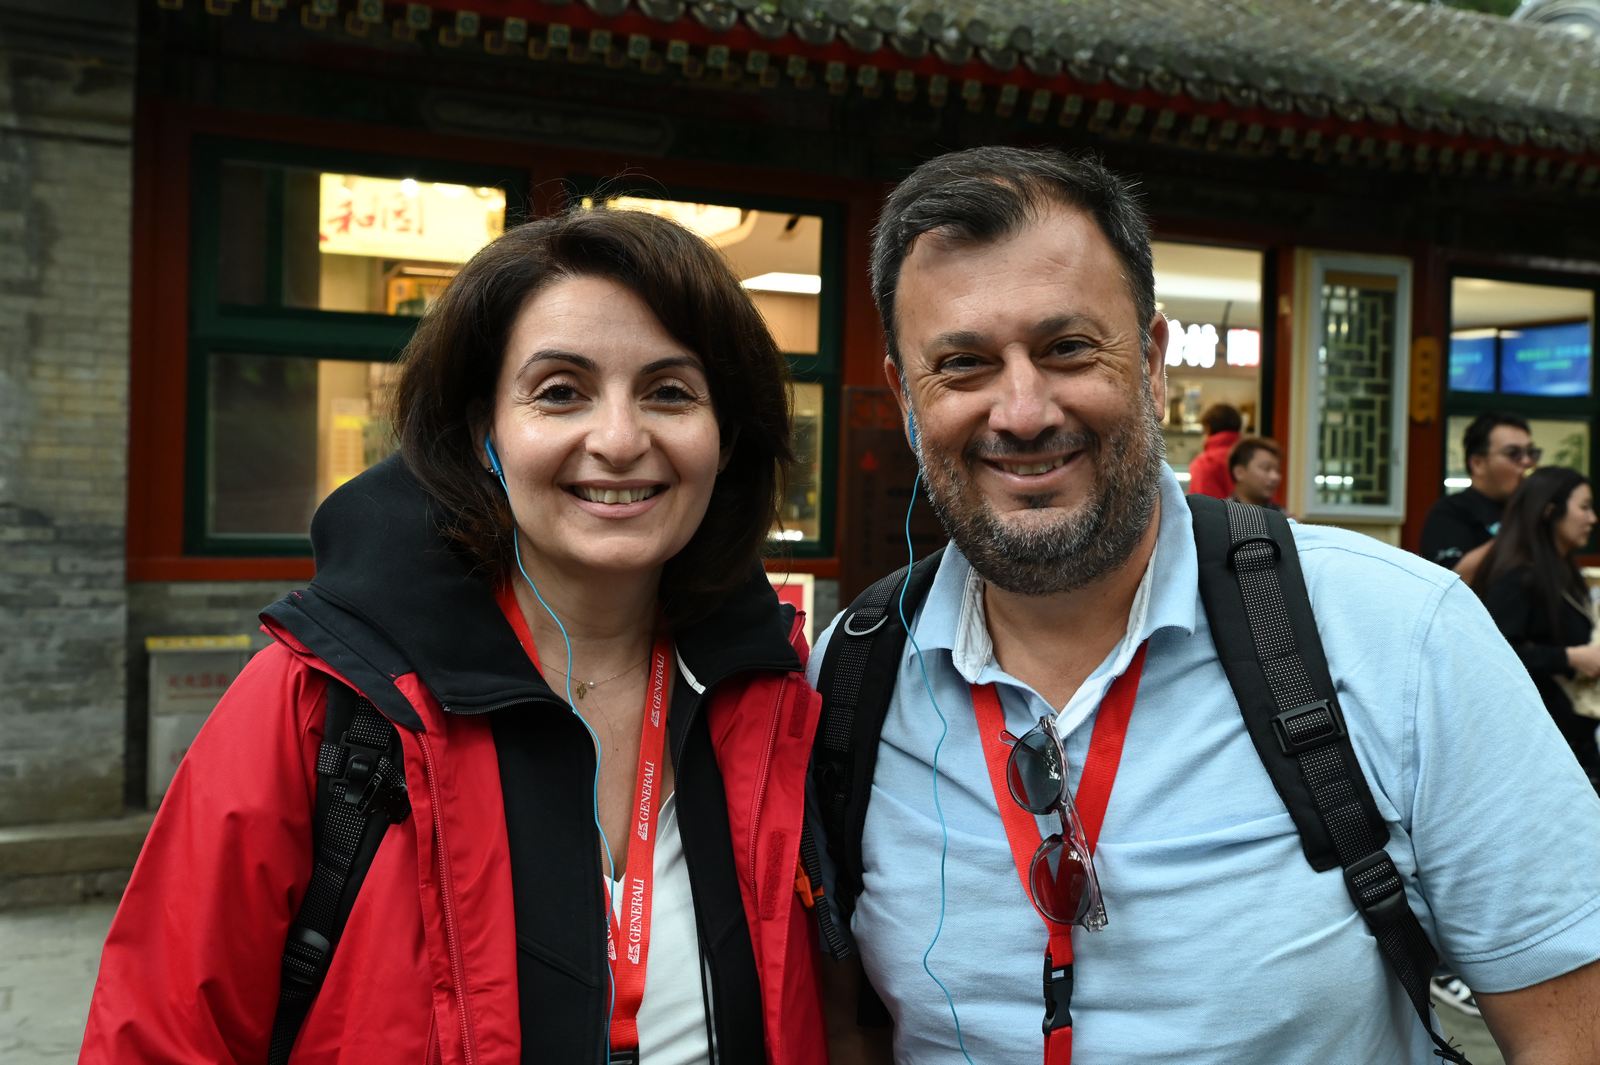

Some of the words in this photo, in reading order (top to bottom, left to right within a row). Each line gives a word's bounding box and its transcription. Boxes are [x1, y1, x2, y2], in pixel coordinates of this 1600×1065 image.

[653, 652, 665, 709] GENERALI
[639, 760, 655, 821] GENERALI
[629, 878, 645, 943] GENERALI
